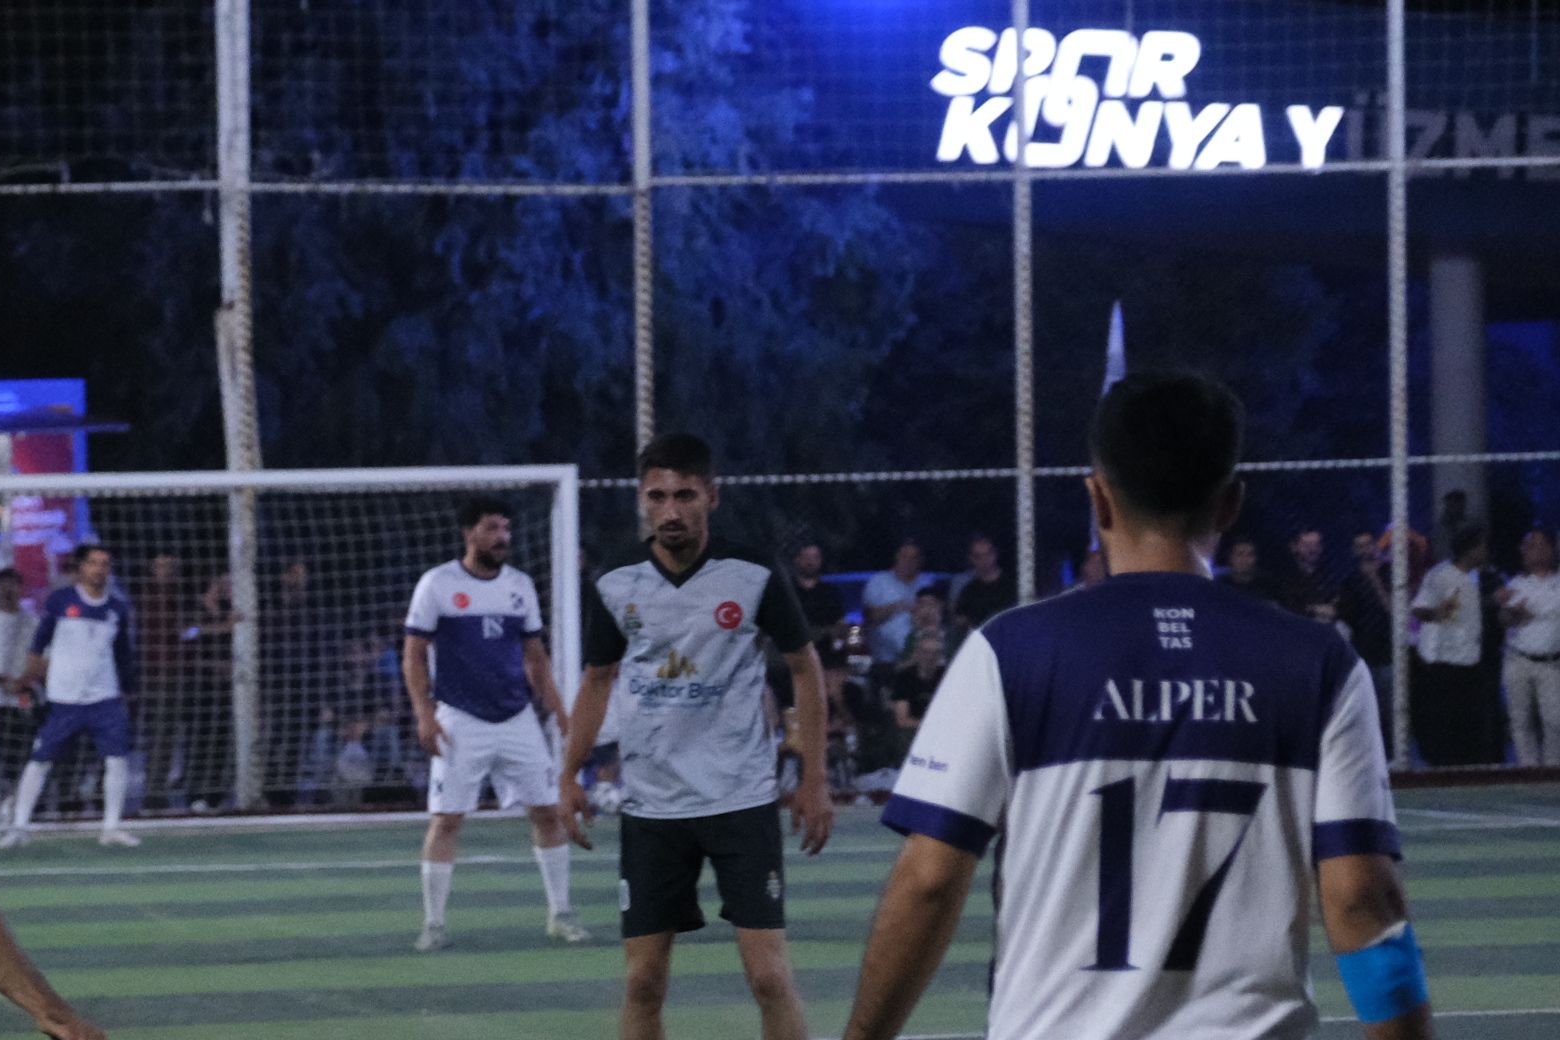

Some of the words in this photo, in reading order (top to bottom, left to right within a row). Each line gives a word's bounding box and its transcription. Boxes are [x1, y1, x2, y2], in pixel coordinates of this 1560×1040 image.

[930, 26, 1201, 98] SPOR
[1153, 607, 1196, 619] KON
[1156, 621, 1192, 633] BEL
[1092, 677, 1259, 724] ALPER
[1078, 775, 1269, 972] 17
